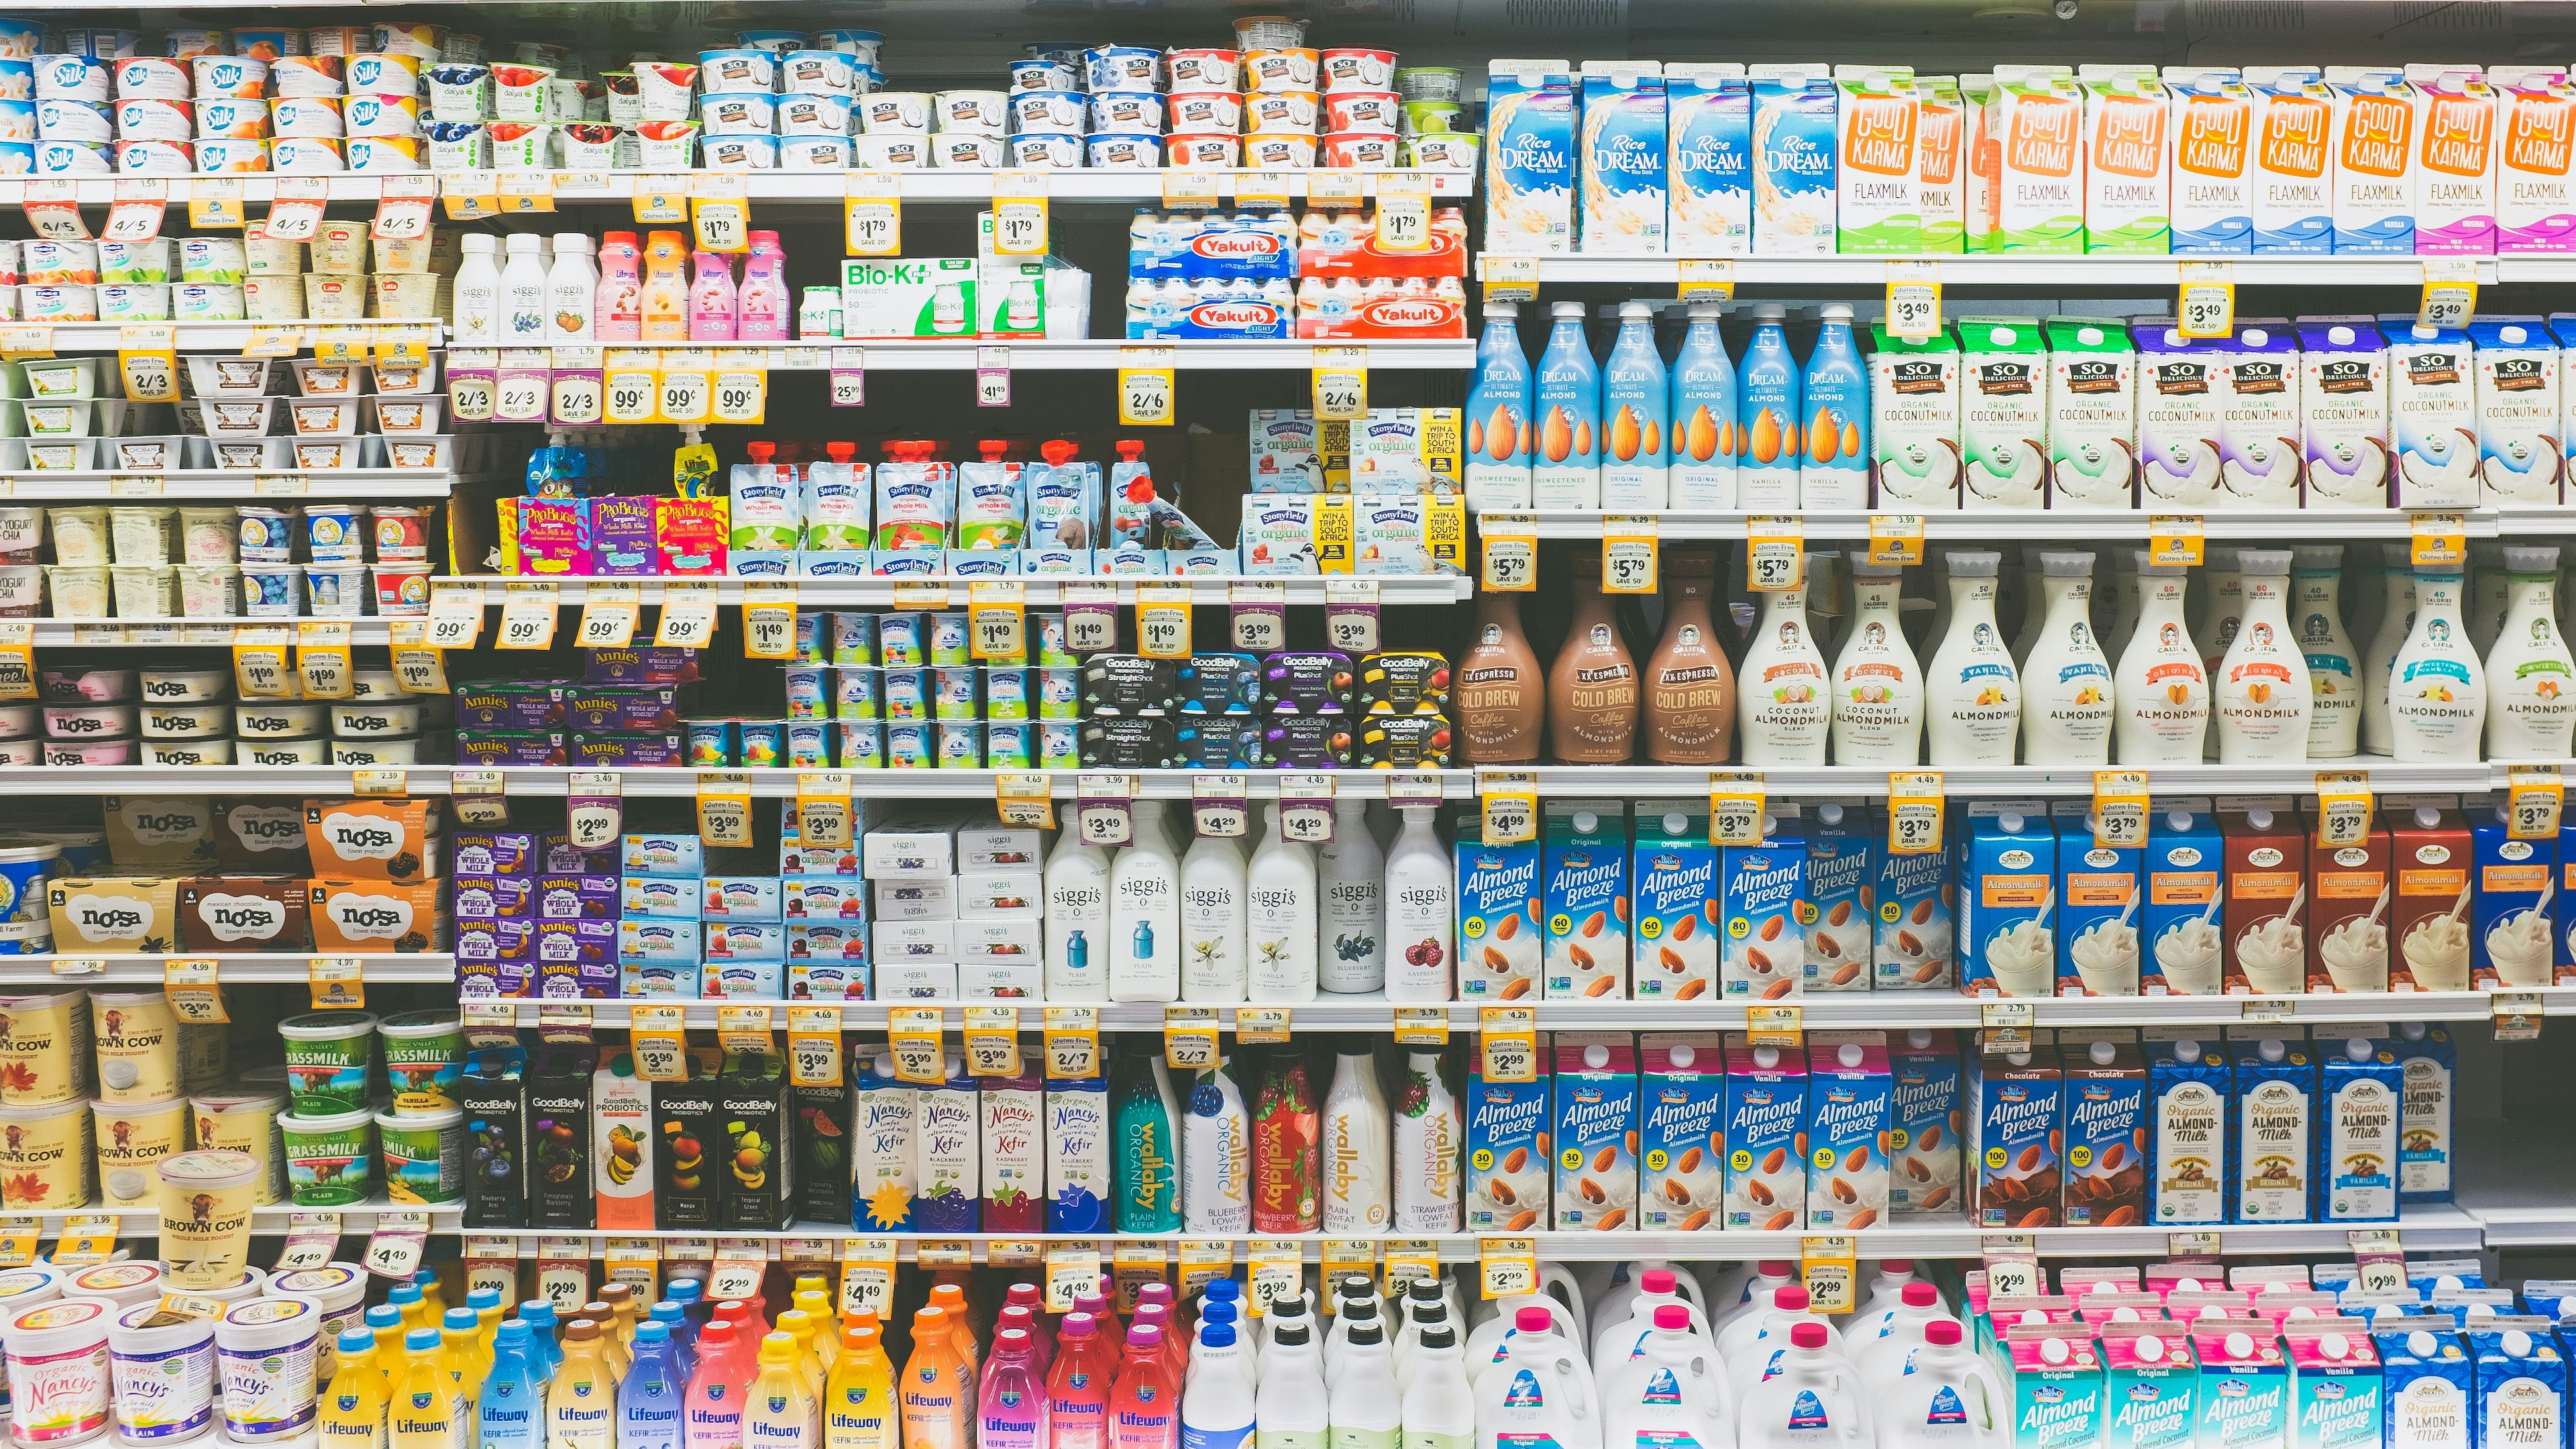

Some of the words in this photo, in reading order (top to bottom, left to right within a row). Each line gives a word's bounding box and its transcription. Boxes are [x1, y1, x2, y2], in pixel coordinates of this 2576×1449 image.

[727, 60, 742, 68] SO
[1332, 60, 1352, 68] SO
[54, 65, 87, 88] Silk
[1536, 104, 1570, 112] ENRICHED
[206, 105, 235, 128] Silk
[1857, 99, 1907, 137] GOOD
[2105, 101, 2156, 140] GOOD
[2192, 101, 2241, 144] GOOD
[2434, 99, 2485, 138] GOOD
[1517, 135, 1552, 150] Rice
[1782, 137, 1817, 151] Rice
[348, 142, 370, 162] Silk
[1852, 138, 1905, 171] KARMA
[2100, 140, 2154, 172] KARMA
[2186, 140, 2239, 172] KARMA
[1854, 184, 1908, 199] FLAXMILK
[2104, 185, 2155, 201] FLAXMILK
[2189, 185, 2241, 201] FLAXMILK
[2431, 184, 2482, 200] FLAXMILK
[1207, 239, 1267, 253] Yakult
[1379, 308, 1442, 322] Yakult
[1904, 364, 1931, 376] SO
[2332, 363, 2359, 374] SO
[1809, 393, 1844, 401] ALMOND
[2503, 398, 2536, 406] ORGANIC
[1901, 400, 1937, 409] ORGANIC
[1884, 411, 1952, 421] COCONUTMILK
[2149, 411, 2216, 422] COCONUTMILK
[2486, 407, 2553, 418] COCONUTMILK
[741, 486, 784, 499] Stonyfield
[889, 486, 931, 498] Stonyfield
[1320, 525, 1347, 535] SOUTH
[1371, 527, 1419, 539] organic
[1431, 533, 1460, 541] AFRICA
[1106, 658, 1156, 670] GoodBelly
[146, 681, 188, 696] noosa
[466, 695, 508, 711] Annie's
[1458, 689, 1483, 706] COLD
[1486, 688, 1519, 706] BREW
[1657, 690, 1686, 707] COLD
[1689, 688, 1721, 706] BREW
[1952, 710, 2020, 720] ALMONDMILK
[2223, 708, 2300, 719] ALMONDMILK
[2398, 706, 2474, 717] ALMONDMILK
[343, 716, 388, 731] noosa
[1755, 714, 1827, 726] ALMONDMILK
[337, 828, 392, 846] noosa
[1571, 838, 1601, 847] Original
[1464, 859, 1534, 896] Almond
[2237, 878, 2294, 888] Almondmilk
[2405, 875, 2460, 884] Almondmilk
[1988, 880, 2050, 890] Almondmilk
[1053, 887, 1102, 906] siggi's
[1185, 886, 1232, 906] siggi's
[1480, 880, 1527, 909] Breeze
[1565, 879, 1614, 907] Breeze
[460, 900, 491, 908] WHOLE
[643, 898, 678, 908] organic
[83, 908, 142, 928] noosa
[466, 907, 486, 916] MILK
[1884, 906, 1898, 916] 80
[458, 920, 496, 933] Annie's
[1468, 920, 1482, 930] 60
[2005, 1072, 2040, 1080] Chocolate
[464, 1099, 517, 1112] GoodBelly
[723, 1099, 776, 1111] GoodBelly
[1815, 1097, 1885, 1127] Almond
[2251, 1103, 2300, 1118] Organic
[2253, 1116, 2302, 1128] ALMOND-
[1488, 1116, 1536, 1143] Breeze
[2258, 1128, 2293, 1141] Milk
[287, 1142, 360, 1157] GRASSMILK
[998, 1137, 1028, 1155] Kefir
[1336, 1114, 1349, 1202] wallaby
[1566, 1153, 1578, 1163] 30
[1988, 1151, 2004, 1160] 100
[1140, 1121, 1156, 1211] wallaby
[2350, 1177, 2378, 1185] VANILLA
[1208, 1205, 1248, 1217] BLUEBERRY
[215, 1217, 245, 1230] COW
[1425, 1221, 1447, 1229] KEFIR
[2042, 1371, 2075, 1381] Original
[906, 1391, 951, 1407] Lifeway
[2302, 1385, 2377, 1426] Almond
[1053, 1399, 1103, 1414] Lifeway
[2021, 1391, 2096, 1432] Almond
[2498, 1403, 2551, 1419] Organic
[483, 1407, 529, 1422] Lifeway
[322, 1420, 373, 1437] Lifeway
[753, 1421, 800, 1438] Lifeway
[2037, 1415, 2088, 1443] Breeze
[2500, 1417, 2553, 1430] ALMOND-
[51, 1428, 81, 1438] PLAIN
